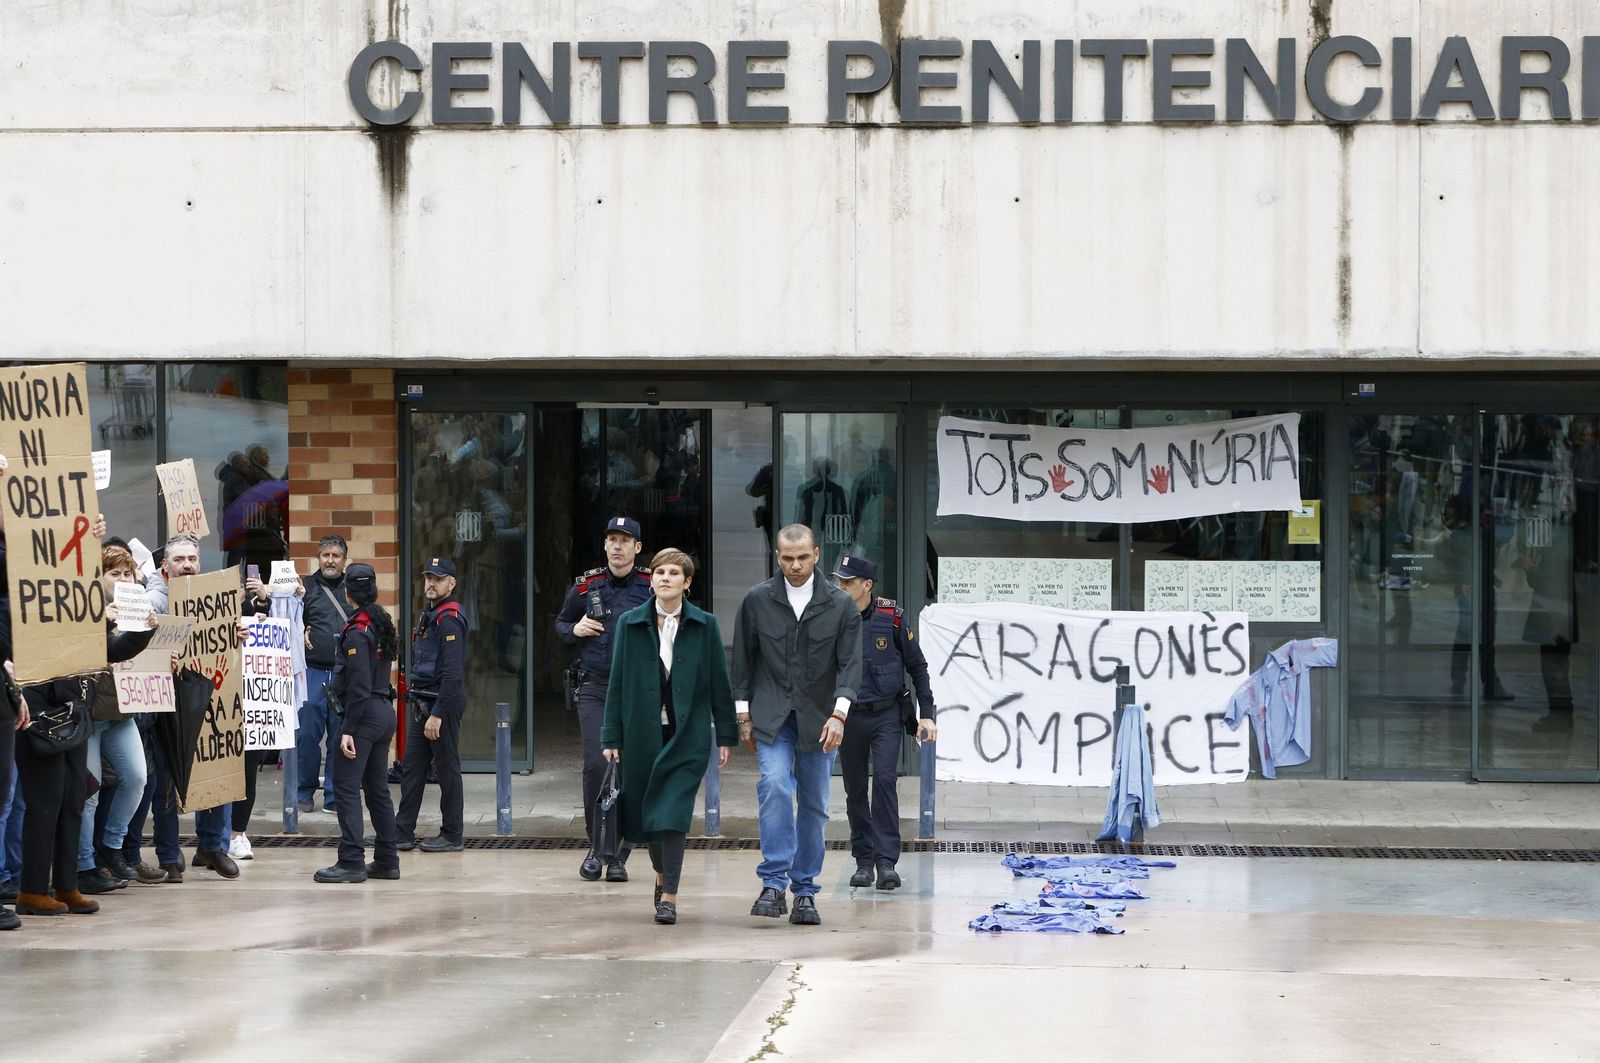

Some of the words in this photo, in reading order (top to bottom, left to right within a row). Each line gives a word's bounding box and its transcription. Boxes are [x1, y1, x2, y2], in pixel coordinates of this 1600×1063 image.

[348, 40, 790, 126] CENTRE
[826, 35, 1600, 123] PENITENCIARI
[0, 371, 83, 421] NÚRIA
[19, 428, 48, 468] NI
[1168, 423, 1298, 493] NÚRIA
[7, 471, 88, 519] OBLIT
[176, 508, 202, 534] CAMP
[32, 528, 57, 568] NI
[19, 566, 105, 624] PERDÓ
[244, 654, 272, 674] PUEDE
[939, 611, 1247, 683] ARAGONÈS
[120, 675, 173, 708] SEGURETAT
[232, 692, 243, 720] A
